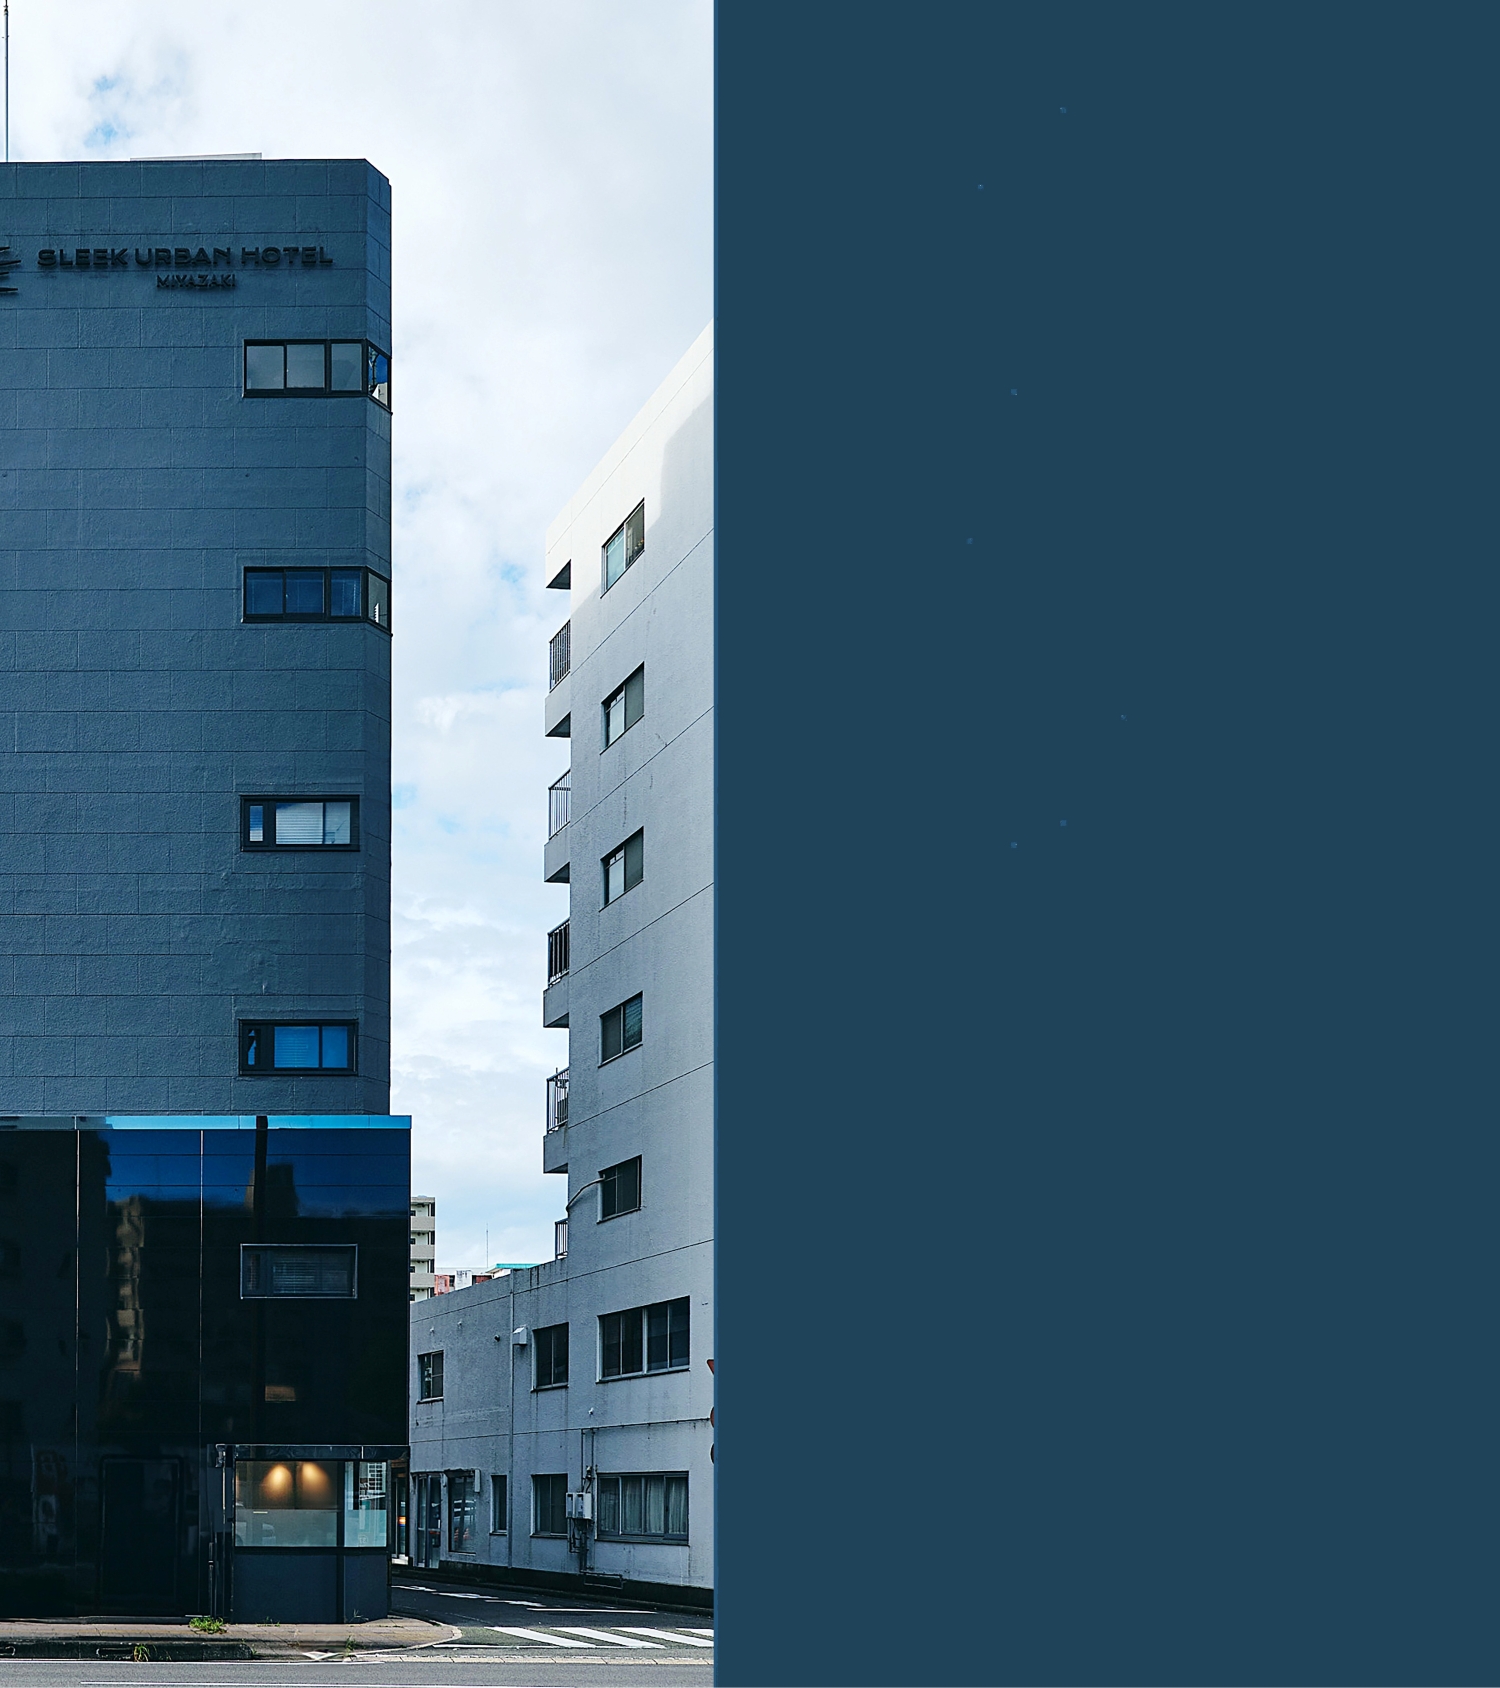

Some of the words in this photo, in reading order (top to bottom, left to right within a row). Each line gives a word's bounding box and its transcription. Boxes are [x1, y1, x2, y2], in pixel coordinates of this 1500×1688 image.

[37, 248, 128, 267] SLEEK
[135, 247, 231, 266] URBAN
[241, 246, 334, 265] HOTEL
[156, 274, 236, 288] MIYAZAKI
